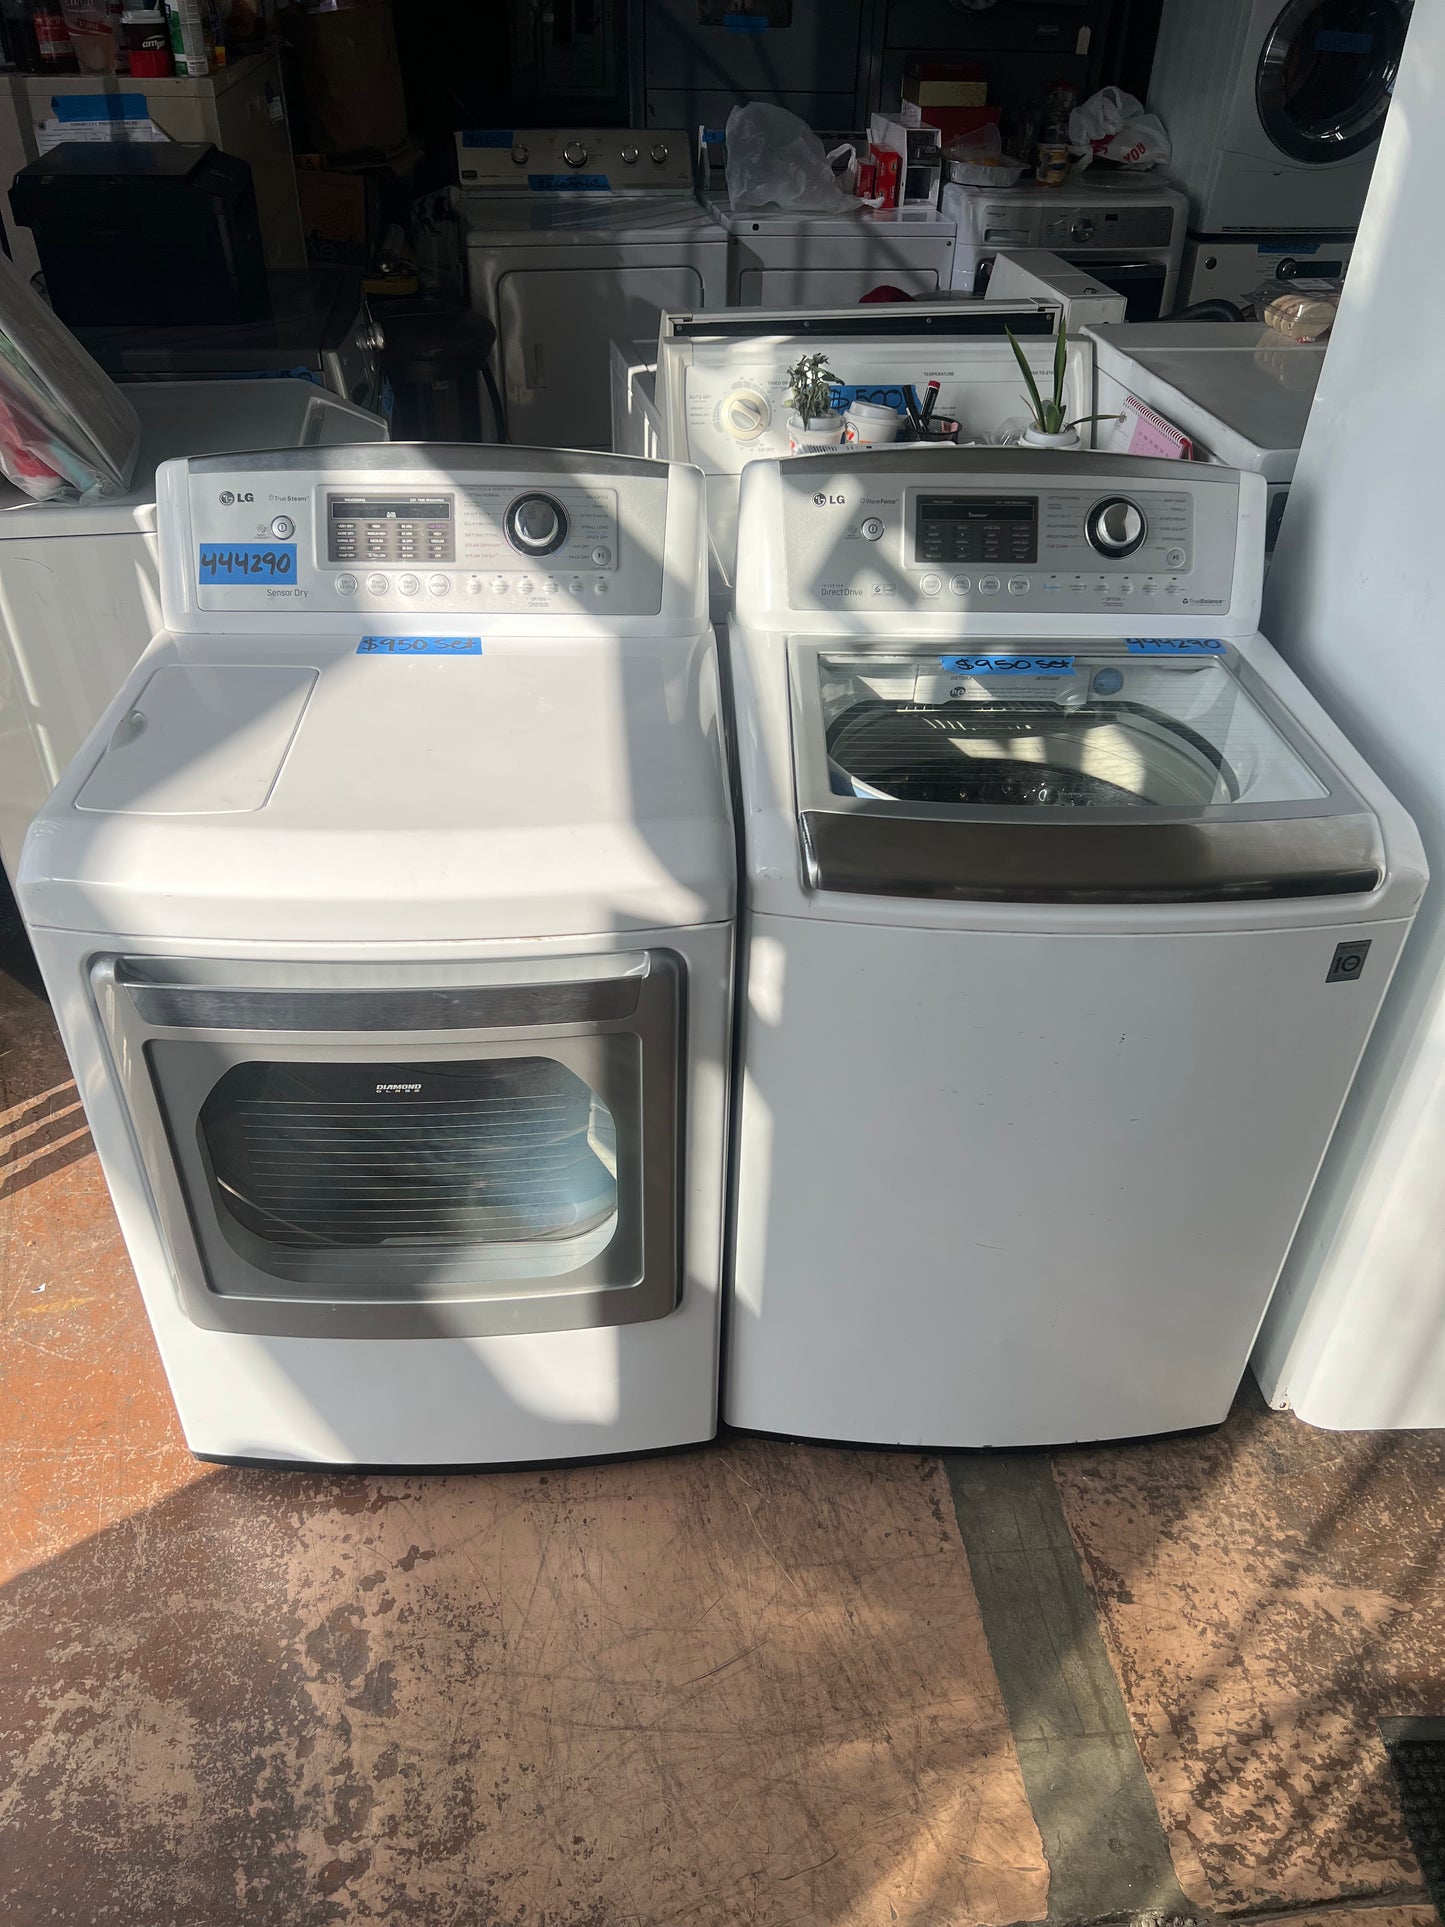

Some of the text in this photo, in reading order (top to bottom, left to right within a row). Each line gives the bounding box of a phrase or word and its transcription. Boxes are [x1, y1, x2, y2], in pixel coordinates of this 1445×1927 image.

[1123, 142, 1146, 162] YOU
[237, 493, 254, 502] LG
[830, 495, 845, 504] LG
[202, 552, 290, 576] 444290
[294, 589, 308, 598] Dry
[362, 637, 428, 651] $950
[1126, 638, 1221, 650] 444290
[956, 658, 1031, 670] $950
